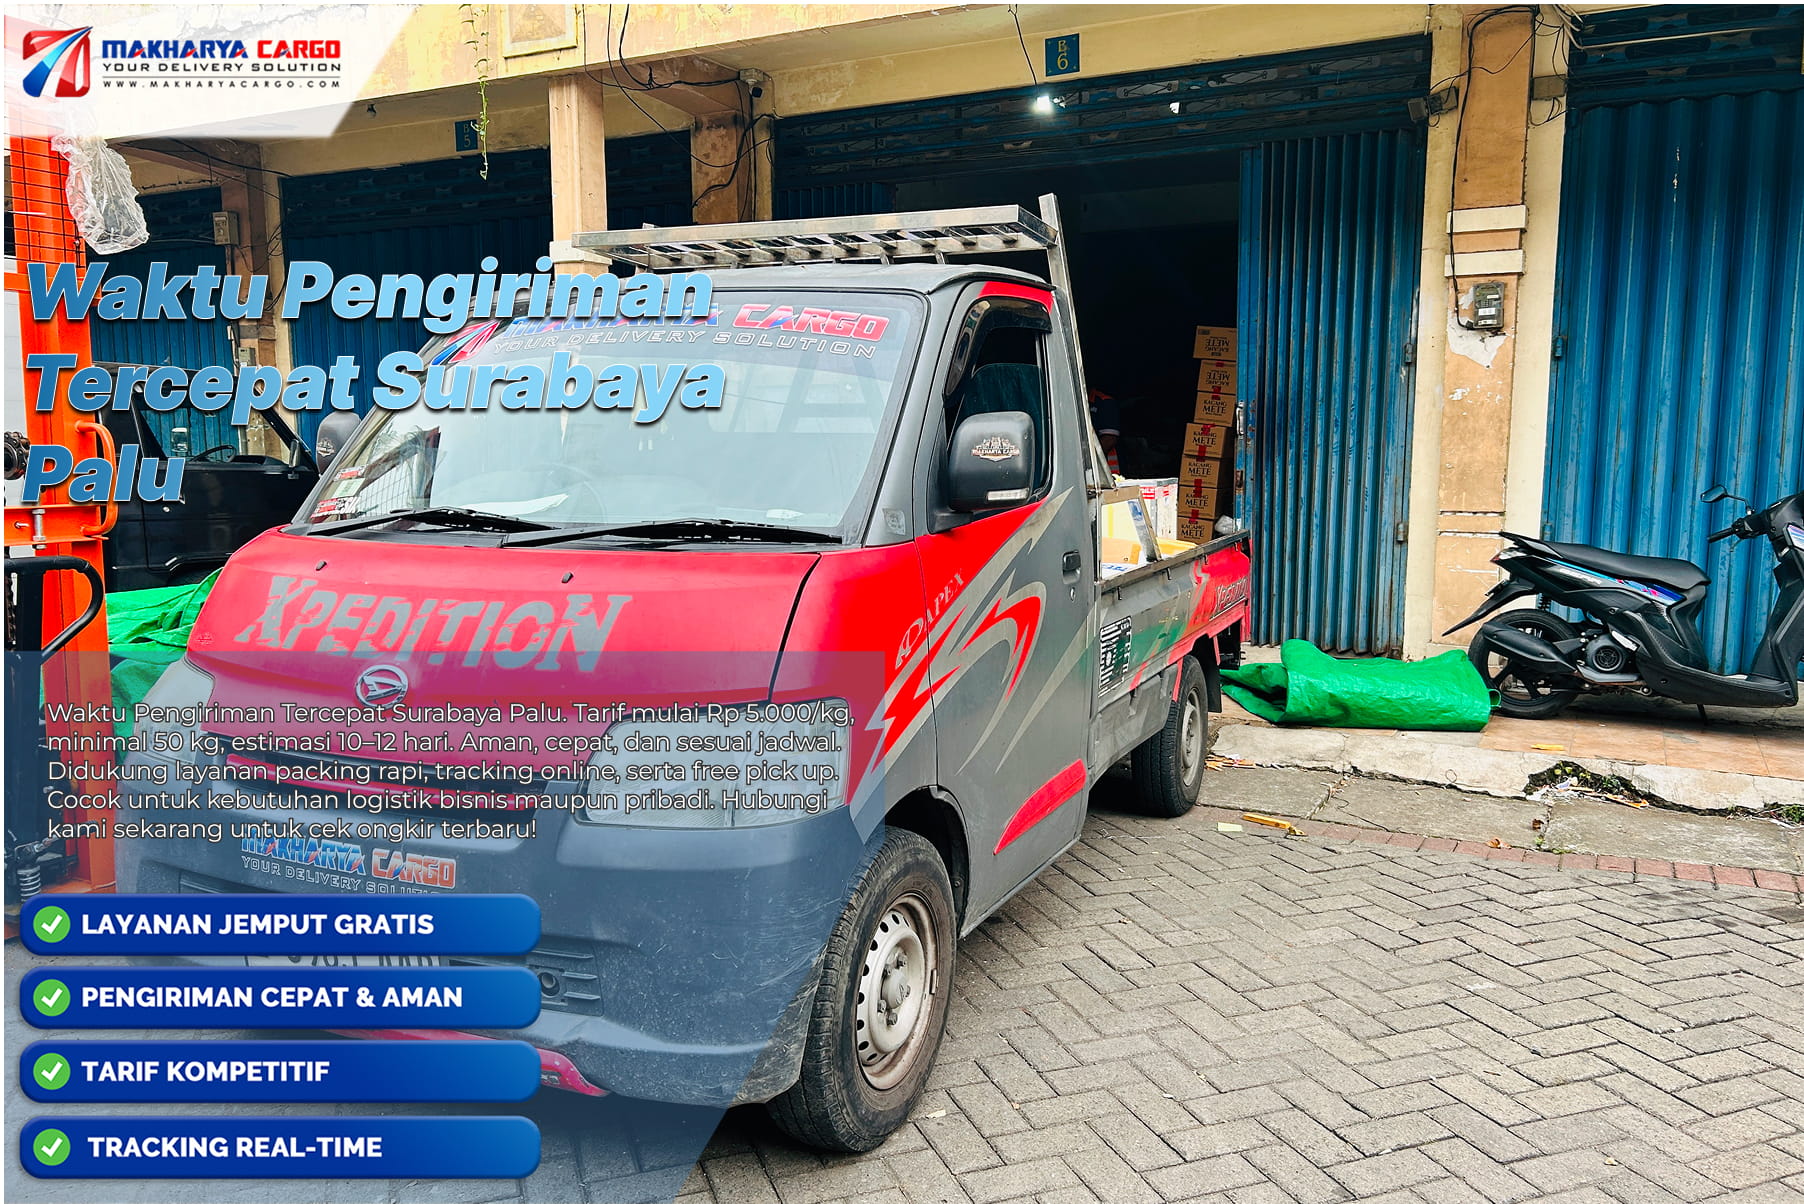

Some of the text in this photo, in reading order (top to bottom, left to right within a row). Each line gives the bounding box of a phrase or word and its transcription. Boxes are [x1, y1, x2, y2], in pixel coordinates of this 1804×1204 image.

[1058, 40, 1068, 52] B
[1057, 53, 1068, 70] 6
[464, 135, 471, 147] 5
[732, 303, 890, 342] CARGO
[495, 330, 877, 358] YOUR DELIVERY SOLUTION
[1203, 405, 1226, 414] METE
[1192, 436, 1216, 445] METE
[1188, 467, 1211, 476] METE
[1185, 498, 1208, 507] METE
[1181, 529, 1204, 538] METE
[234, 576, 633, 672] XPEDITION
[241, 828, 456, 889] MAKHARYA CARGO
[241, 855, 281, 875] YOUR
[285, 866, 361, 891] DELIVERY
